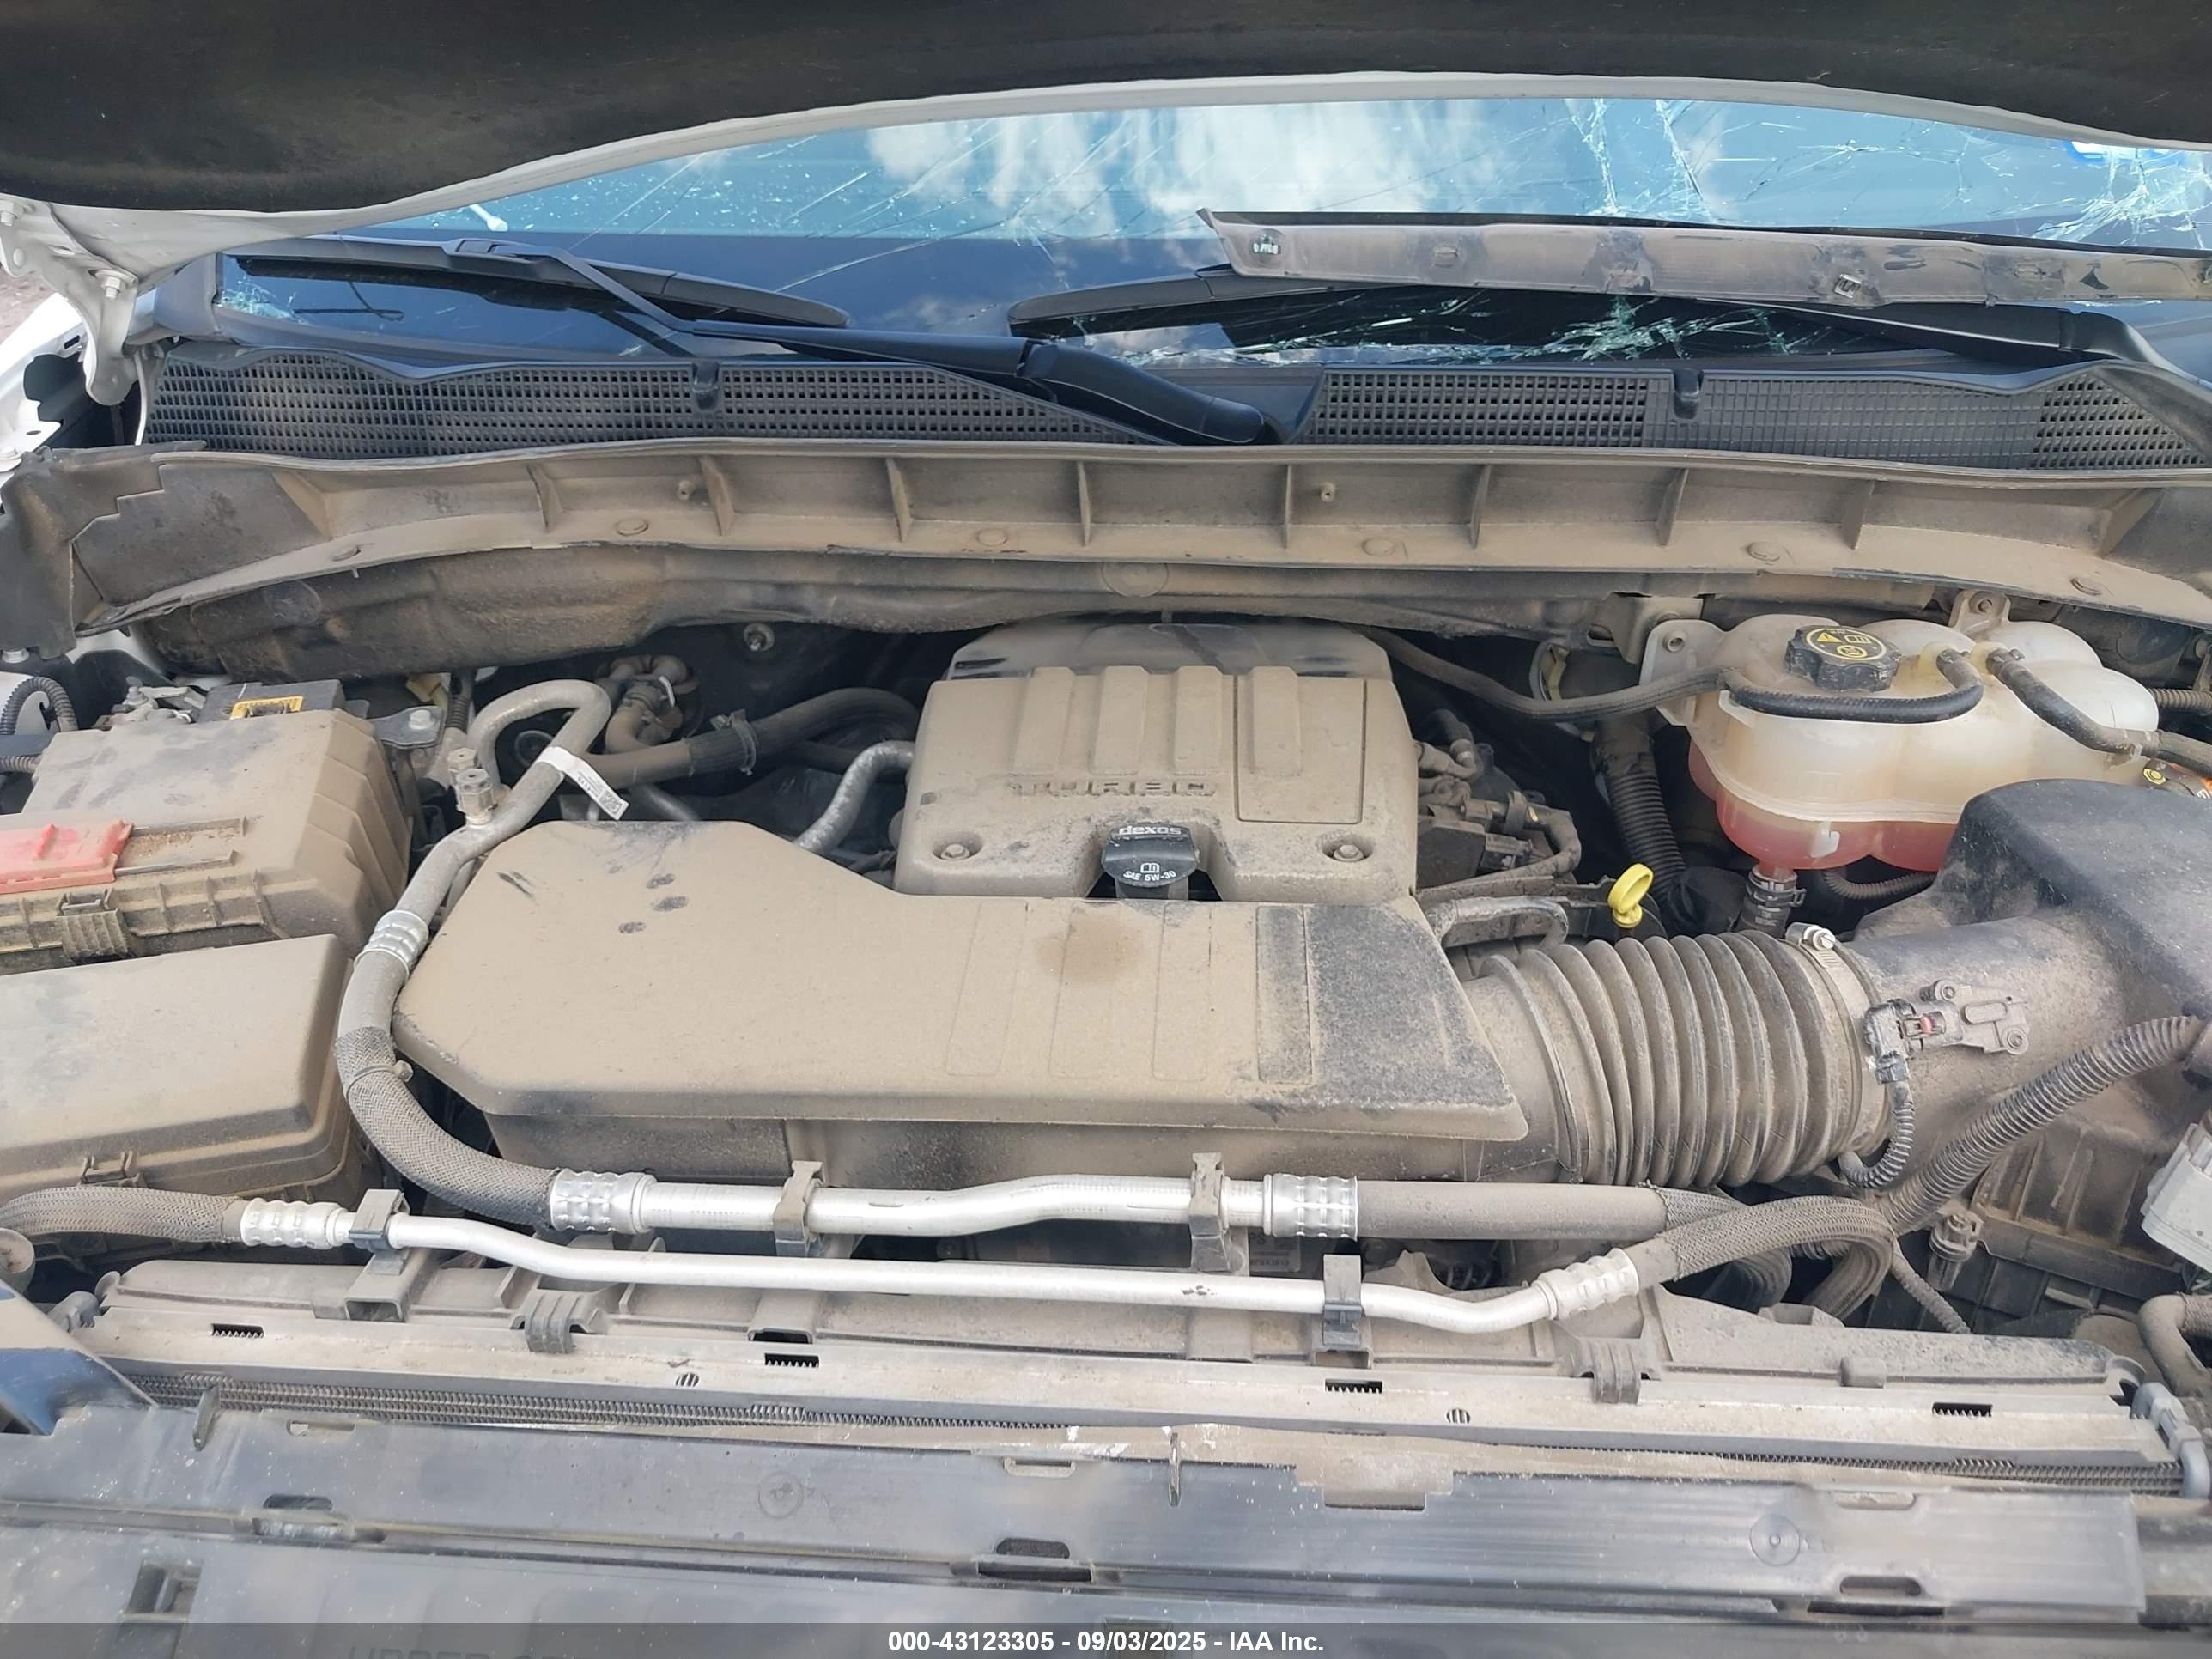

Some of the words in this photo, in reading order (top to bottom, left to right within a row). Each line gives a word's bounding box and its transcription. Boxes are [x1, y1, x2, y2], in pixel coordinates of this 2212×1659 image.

[1119, 825, 1182, 835] dexos
[1123, 871, 1142, 881] SAE
[1145, 870, 1176, 881] 5W-30
